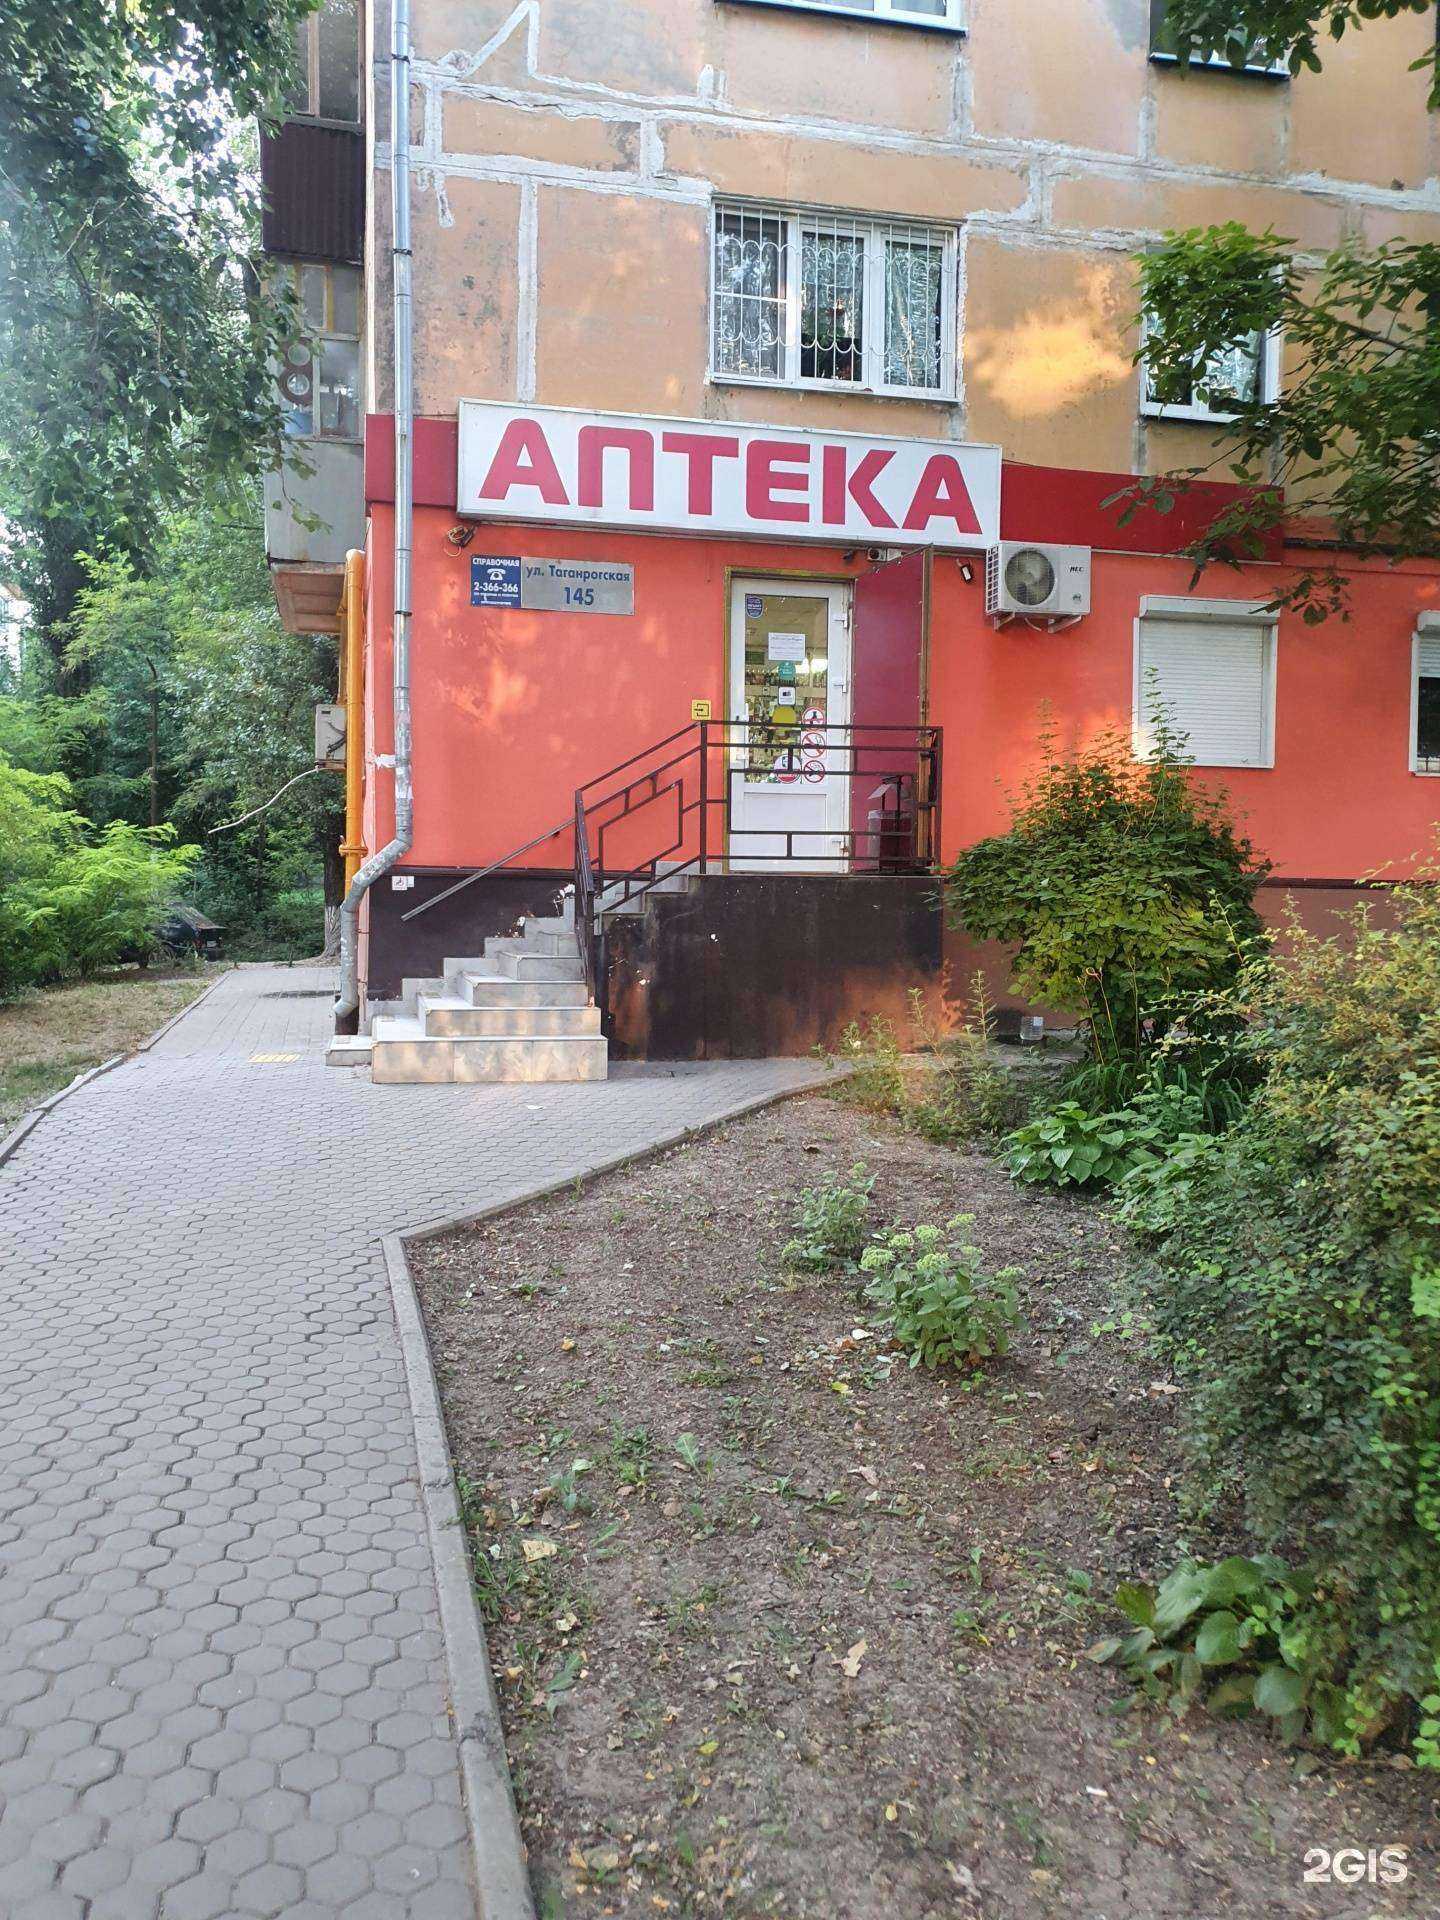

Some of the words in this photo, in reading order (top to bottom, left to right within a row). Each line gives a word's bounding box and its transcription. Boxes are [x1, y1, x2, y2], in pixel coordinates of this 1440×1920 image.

[478, 418, 983, 535] АПТЕКА
[472, 557, 520, 567] СПРАВОЧНАЯ
[526, 566, 545, 577] ул.
[549, 565, 630, 582] Таганрогская
[473, 582, 519, 593] 2-366-366
[564, 587, 595, 606] 145
